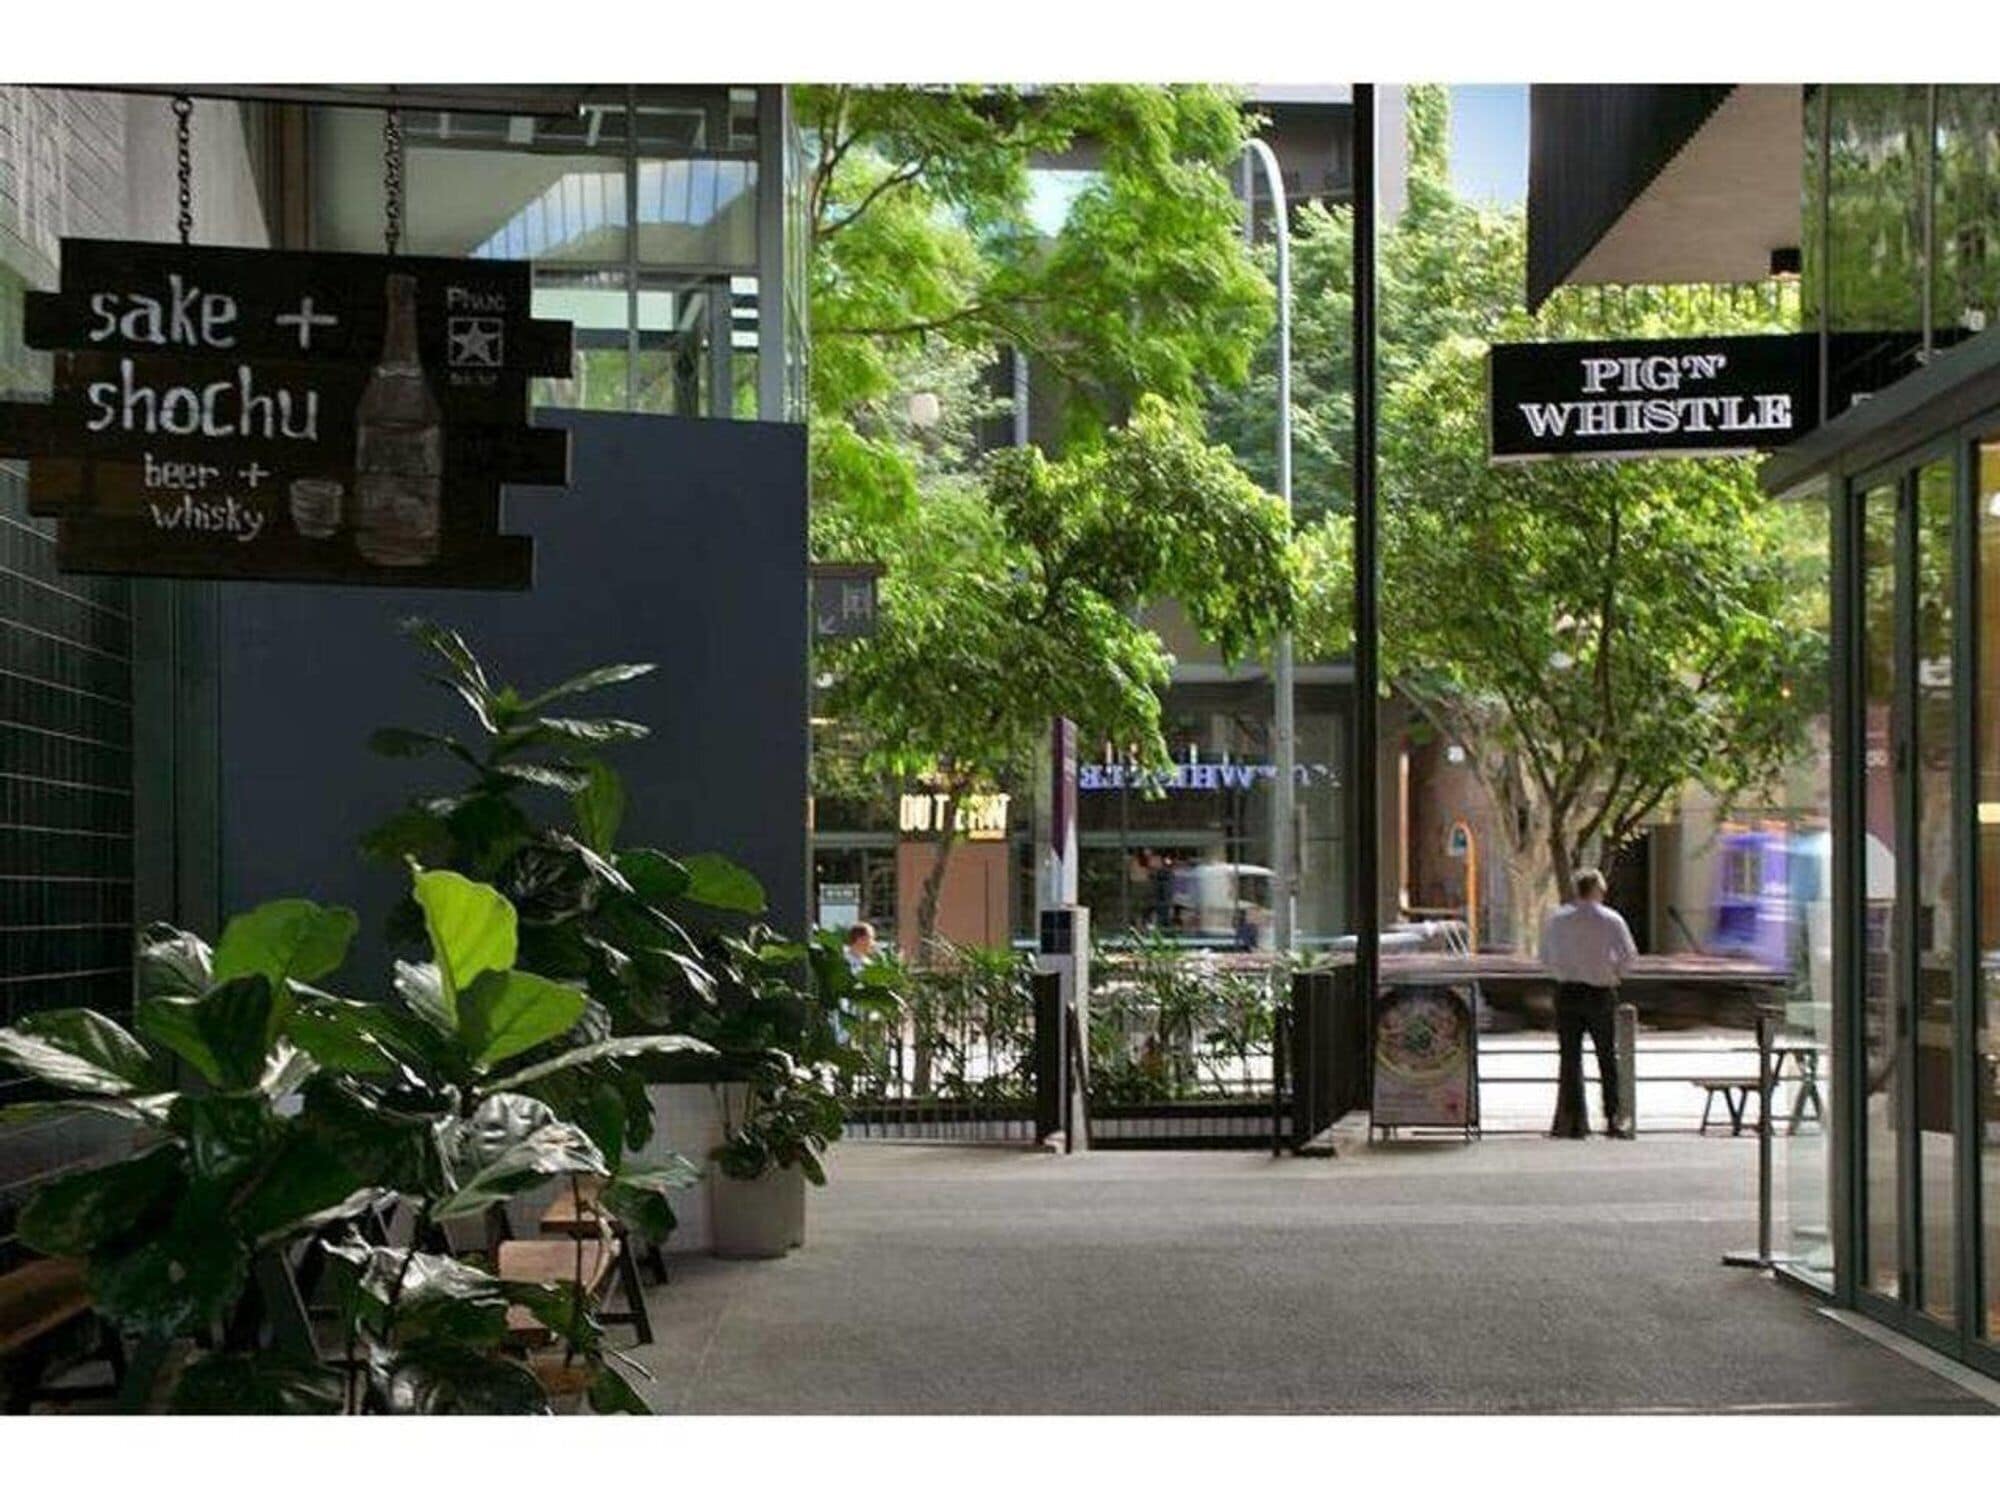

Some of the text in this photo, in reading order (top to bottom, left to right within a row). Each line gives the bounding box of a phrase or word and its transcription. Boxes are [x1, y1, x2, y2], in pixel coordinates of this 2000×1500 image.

[89, 274, 237, 347] sake
[88, 358, 318, 440] shochu
[1519, 394, 1793, 437] WHISTLE
[144, 452, 220, 490] beer
[150, 494, 265, 542] whisky
